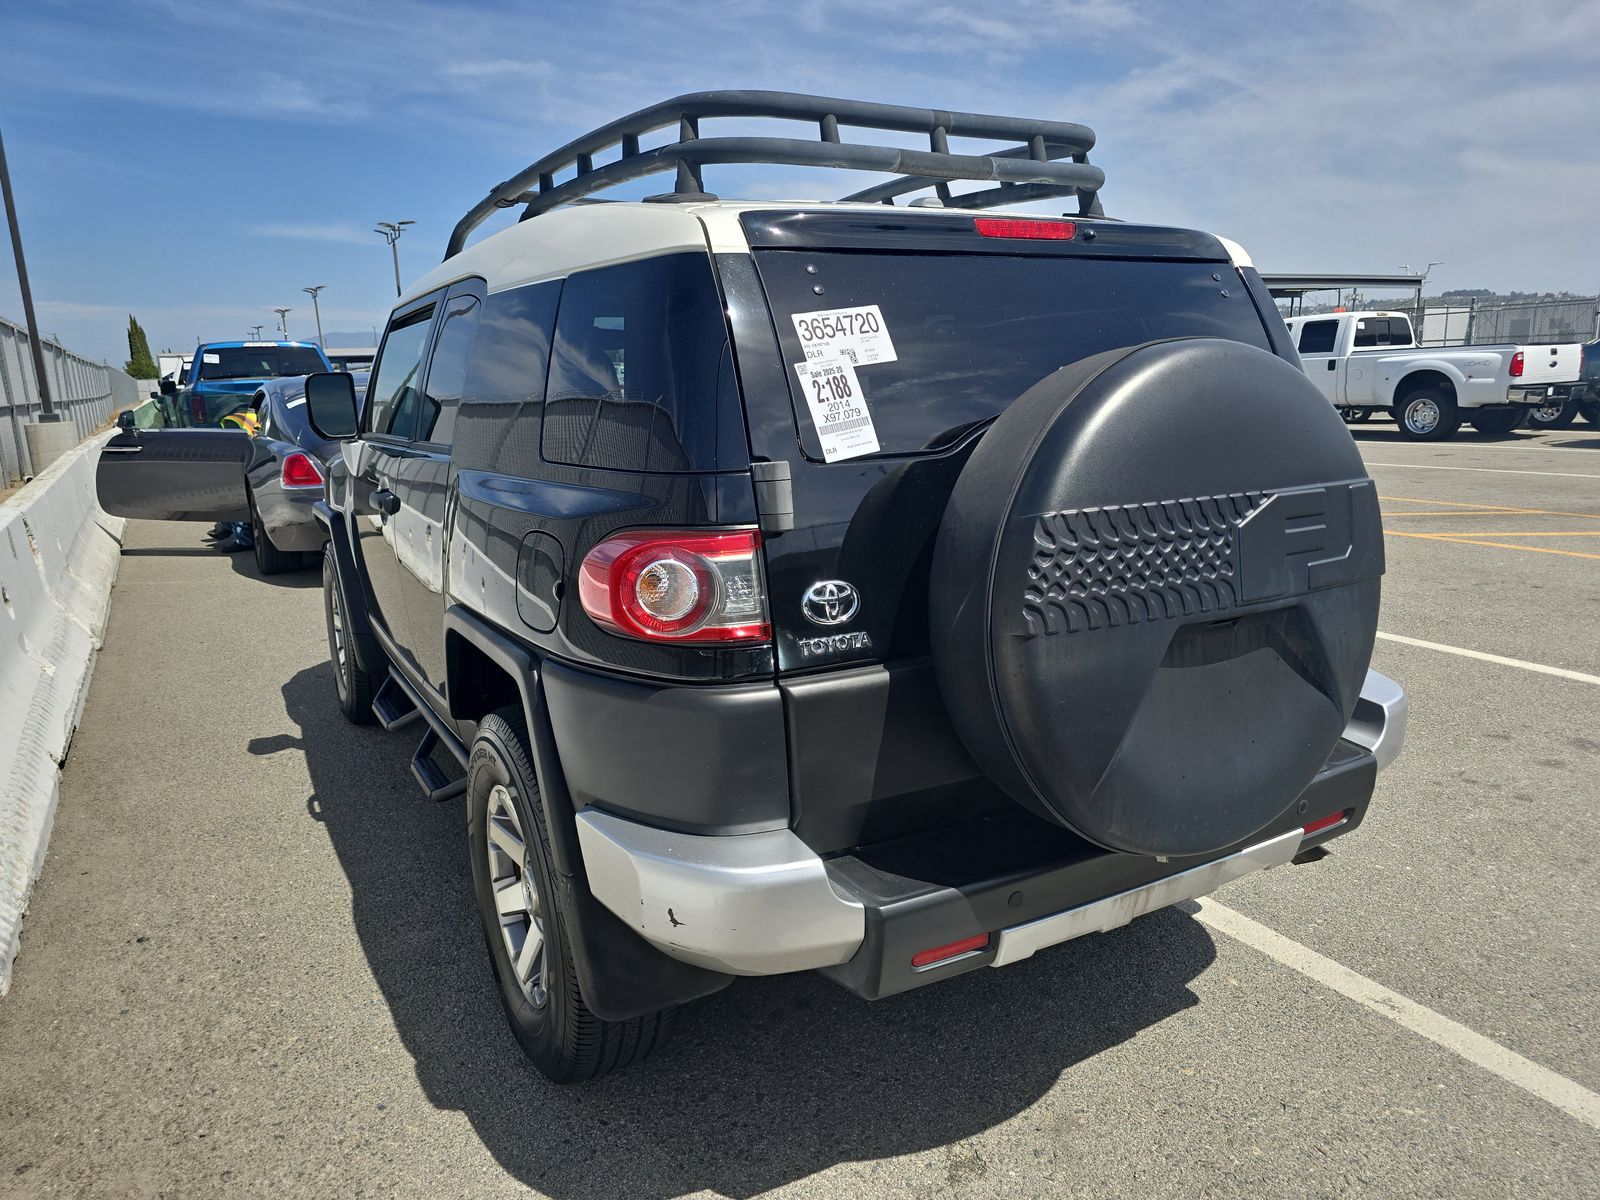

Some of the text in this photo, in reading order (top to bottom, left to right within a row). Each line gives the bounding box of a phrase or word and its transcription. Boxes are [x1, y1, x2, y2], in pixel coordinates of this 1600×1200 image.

[798, 312, 879, 341] 3654720
[806, 350, 824, 359] DLR
[810, 370, 822, 378] Sale
[823, 367, 835, 376] 2025
[827, 400, 851, 413] 2014
[825, 447, 838, 455] DLR
[799, 632, 872, 656] TOYOTA
